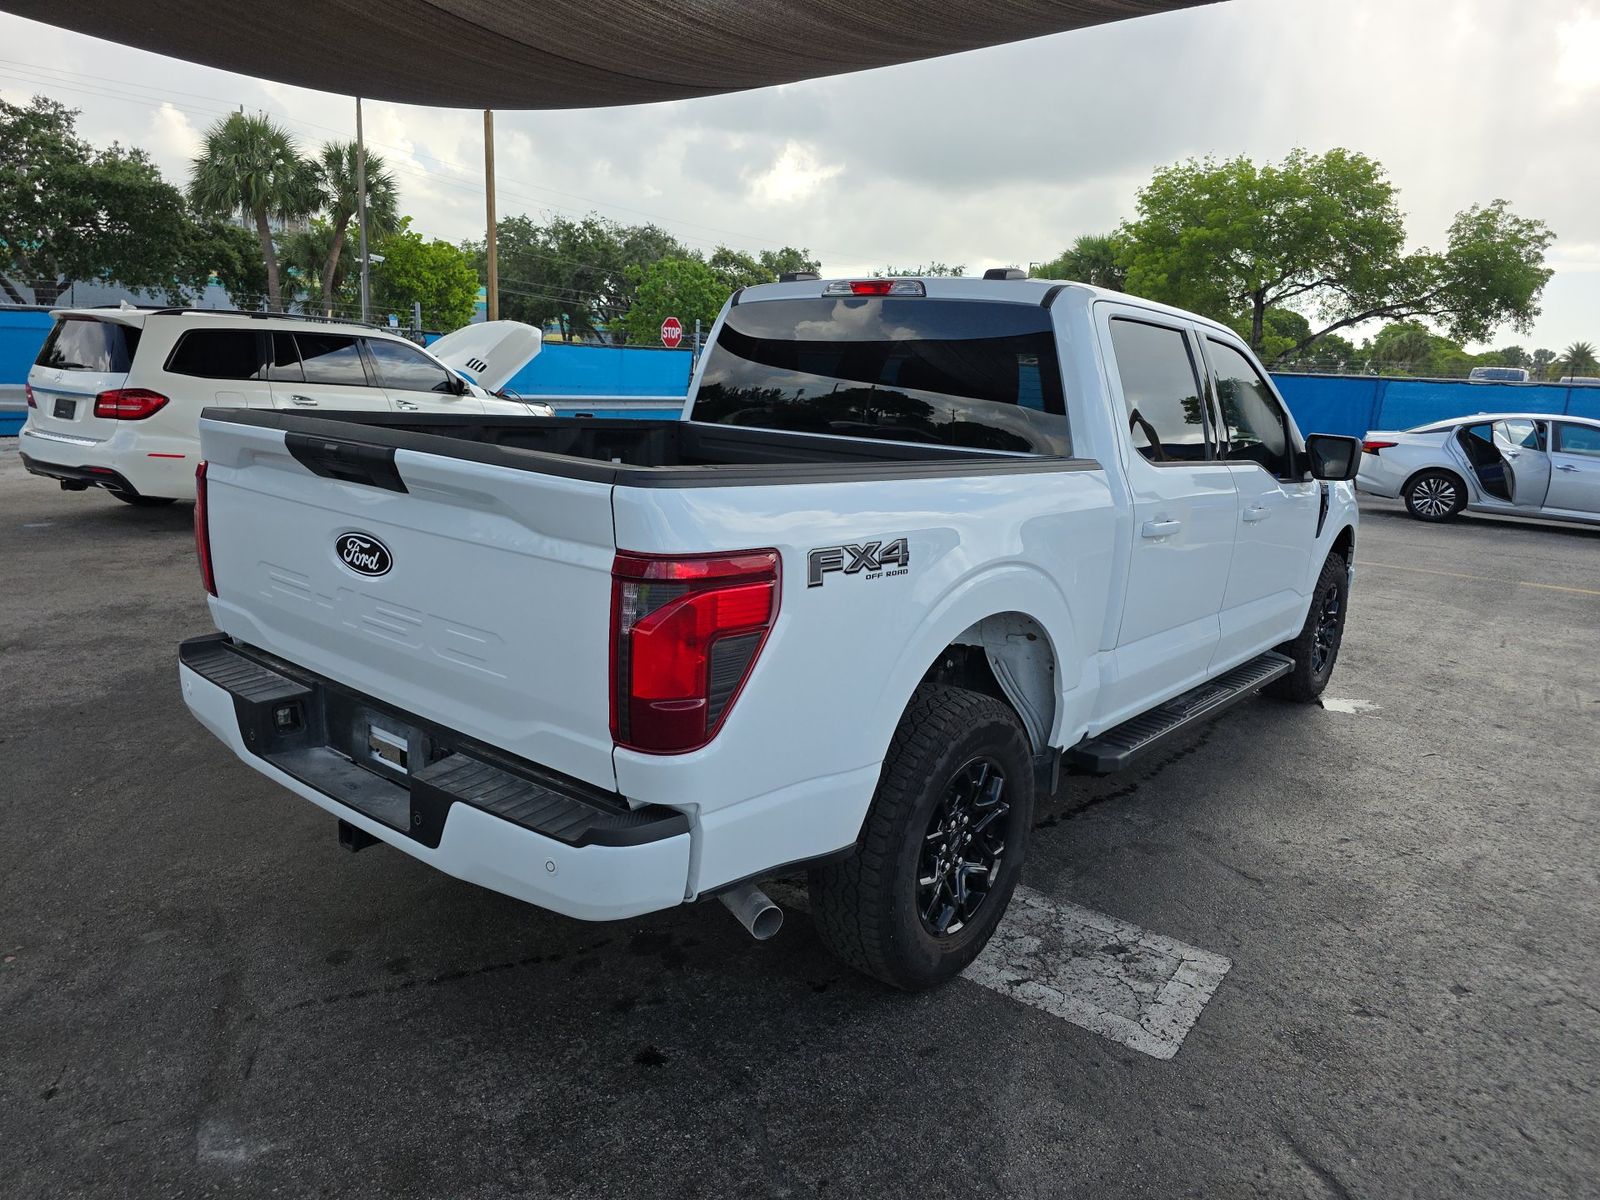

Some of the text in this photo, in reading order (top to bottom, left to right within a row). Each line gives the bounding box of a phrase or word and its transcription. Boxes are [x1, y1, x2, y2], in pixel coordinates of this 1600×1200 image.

[663, 327, 680, 339] STOP
[343, 537, 380, 570] Ford
[807, 538, 909, 589] FX4
[865, 568, 909, 580] OFF ROAD
